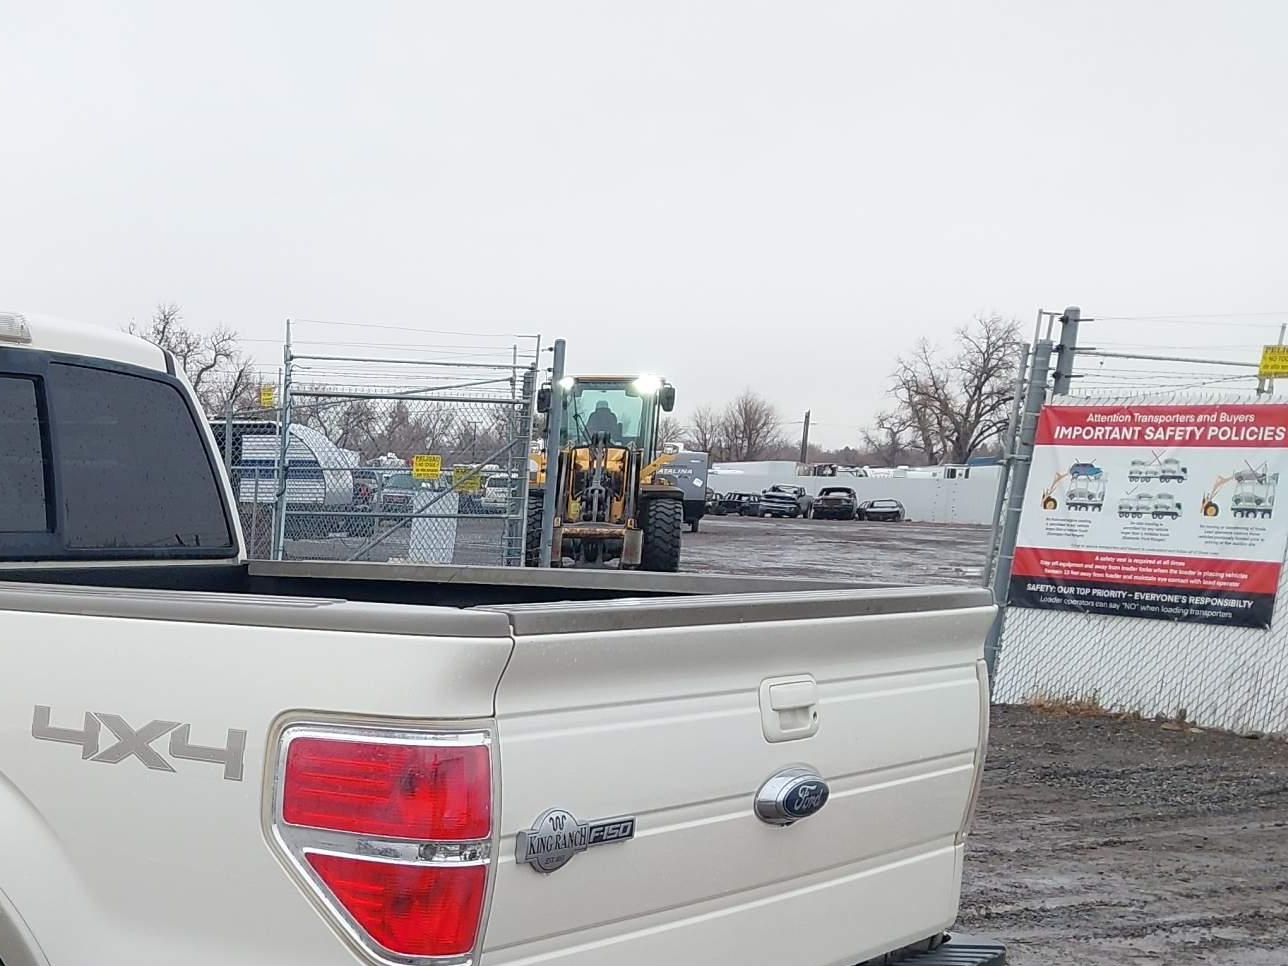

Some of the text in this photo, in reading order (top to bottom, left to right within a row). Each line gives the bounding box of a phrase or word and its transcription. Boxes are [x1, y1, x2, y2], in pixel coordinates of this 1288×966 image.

[1086, 412, 1255, 424] Attention Transporters and Buyers
[1054, 426, 1286, 440] IMPORTANT SAFETY POLICIES
[1027, 584, 1056, 592] SAFETY:
[1057, 586, 1075, 594] OUR
[1092, 589, 1127, 598] PRIORITY
[1161, 606, 1188, 615] loading
[1190, 609, 1232, 618] transporters
[32, 704, 247, 781] 4X4
[794, 784, 824, 810] Ford
[528, 826, 587, 856] KING RANCH
